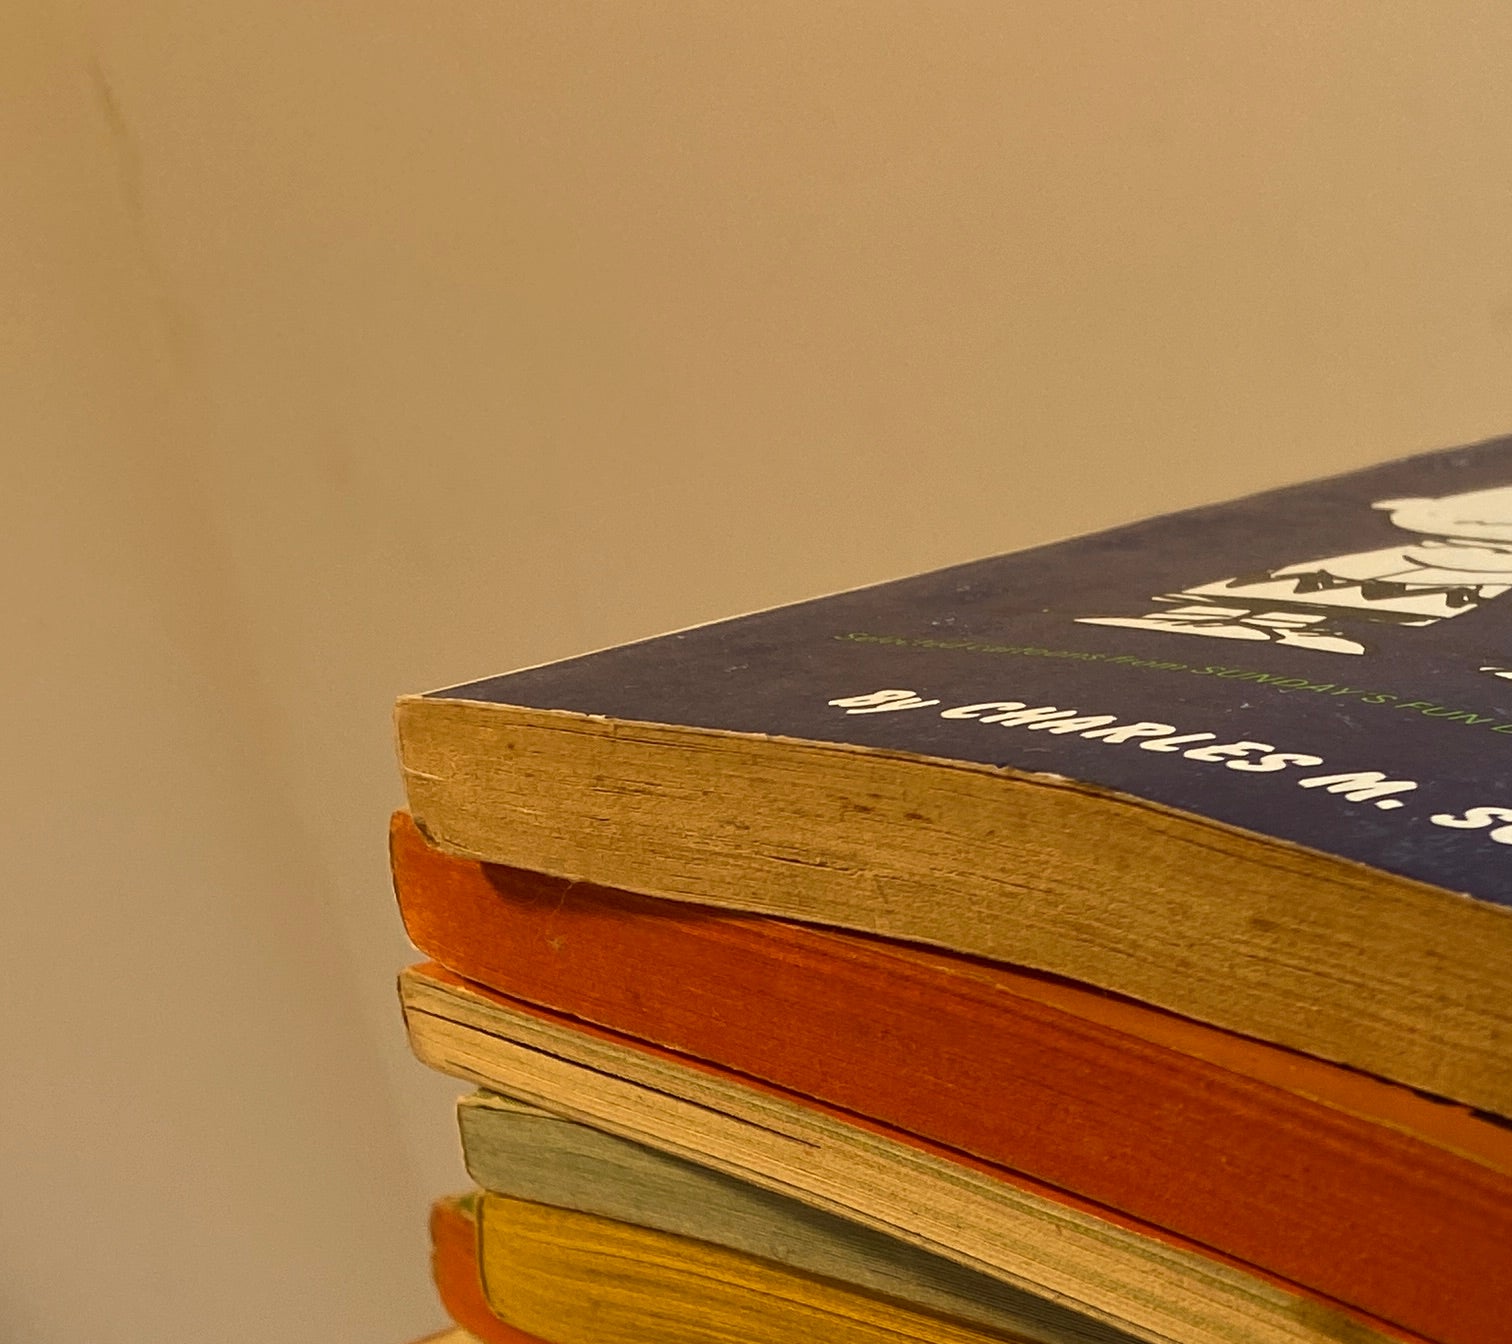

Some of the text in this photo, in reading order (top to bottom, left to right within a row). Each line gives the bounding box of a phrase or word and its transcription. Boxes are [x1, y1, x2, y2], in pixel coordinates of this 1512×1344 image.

[1394, 701, 1493, 725] FUN
[940, 702, 1323, 772] CHARLES
[1297, 771, 1417, 809] M.
